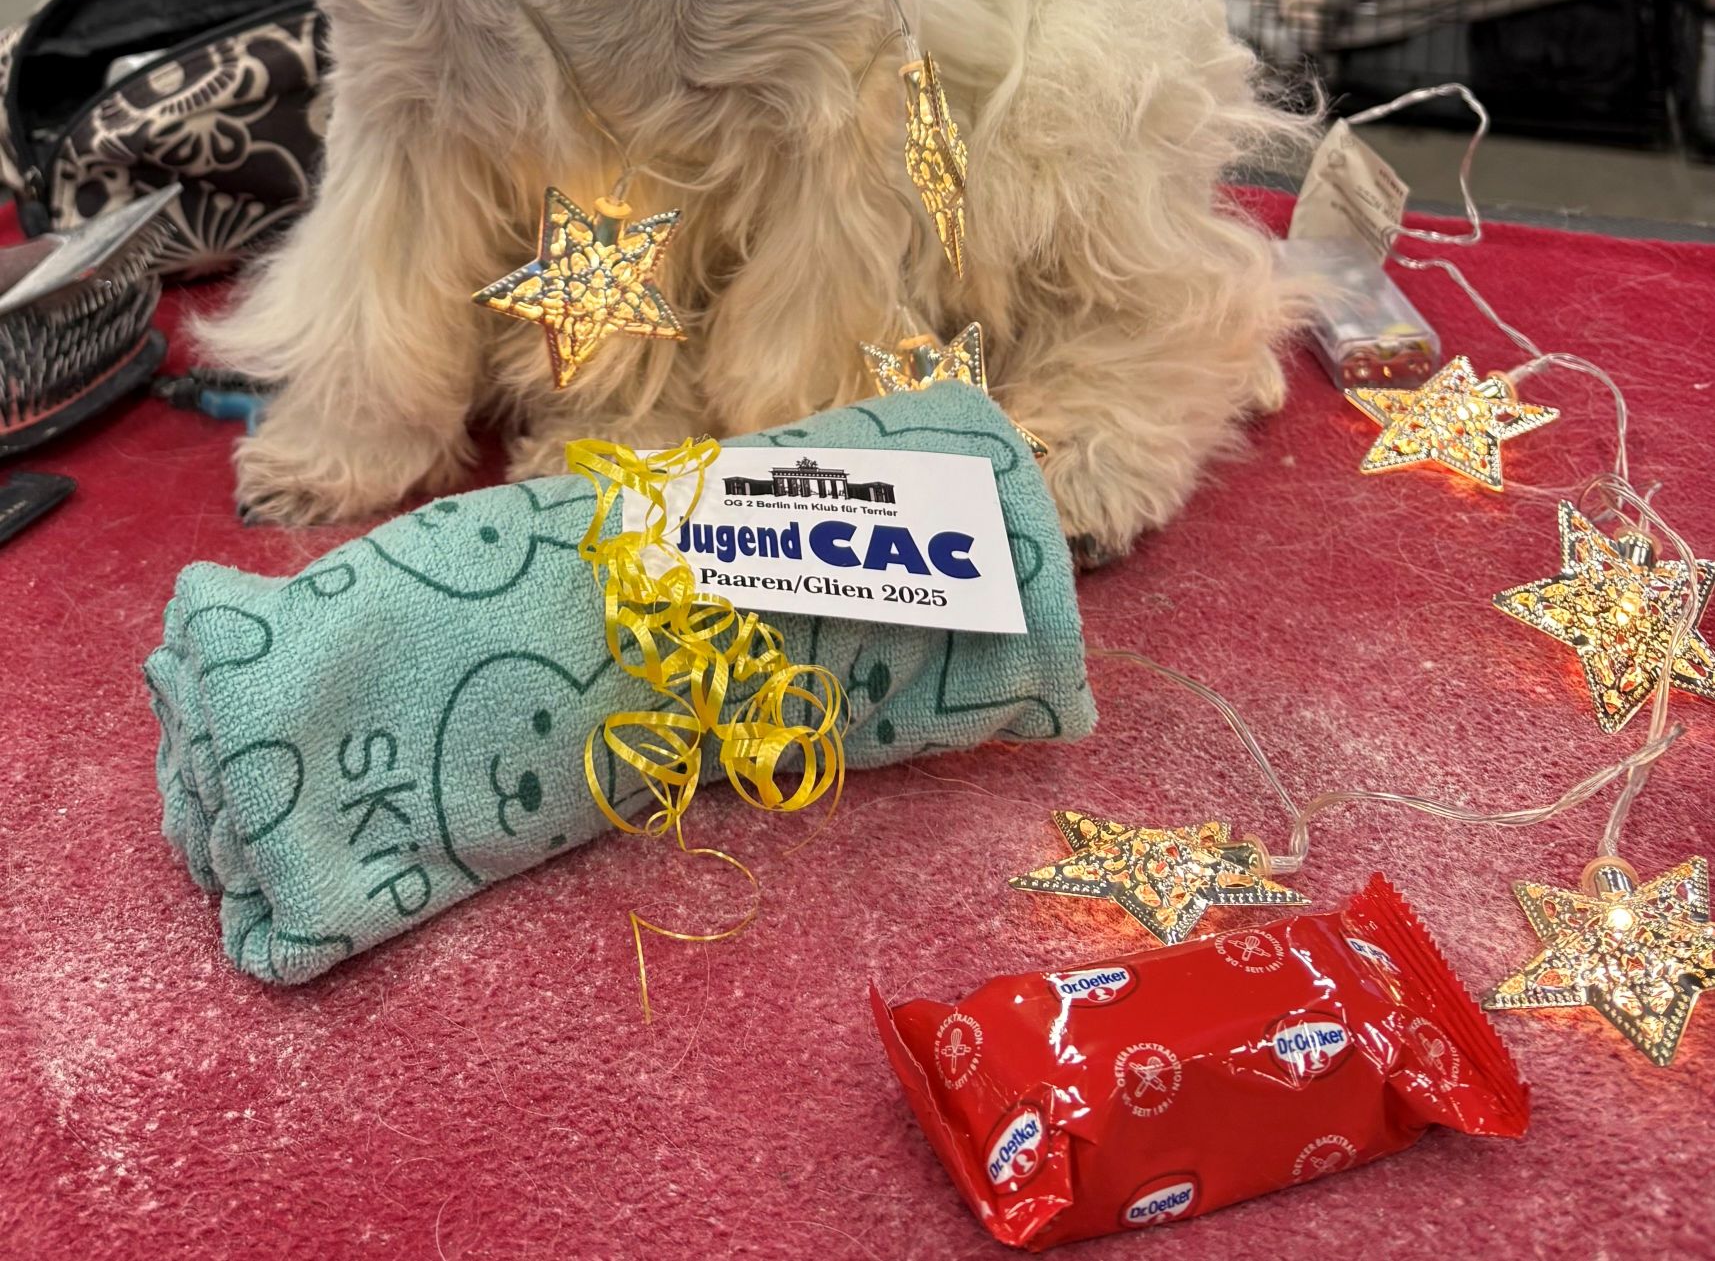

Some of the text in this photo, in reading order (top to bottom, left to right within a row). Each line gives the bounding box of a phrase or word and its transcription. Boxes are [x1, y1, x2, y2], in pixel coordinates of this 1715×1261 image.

[724, 499, 898, 518] OG 2 Berlin im Klub für Terrier
[676, 515, 982, 580] Jugend CAC
[700, 567, 949, 608] Paaren/Glien 2025
